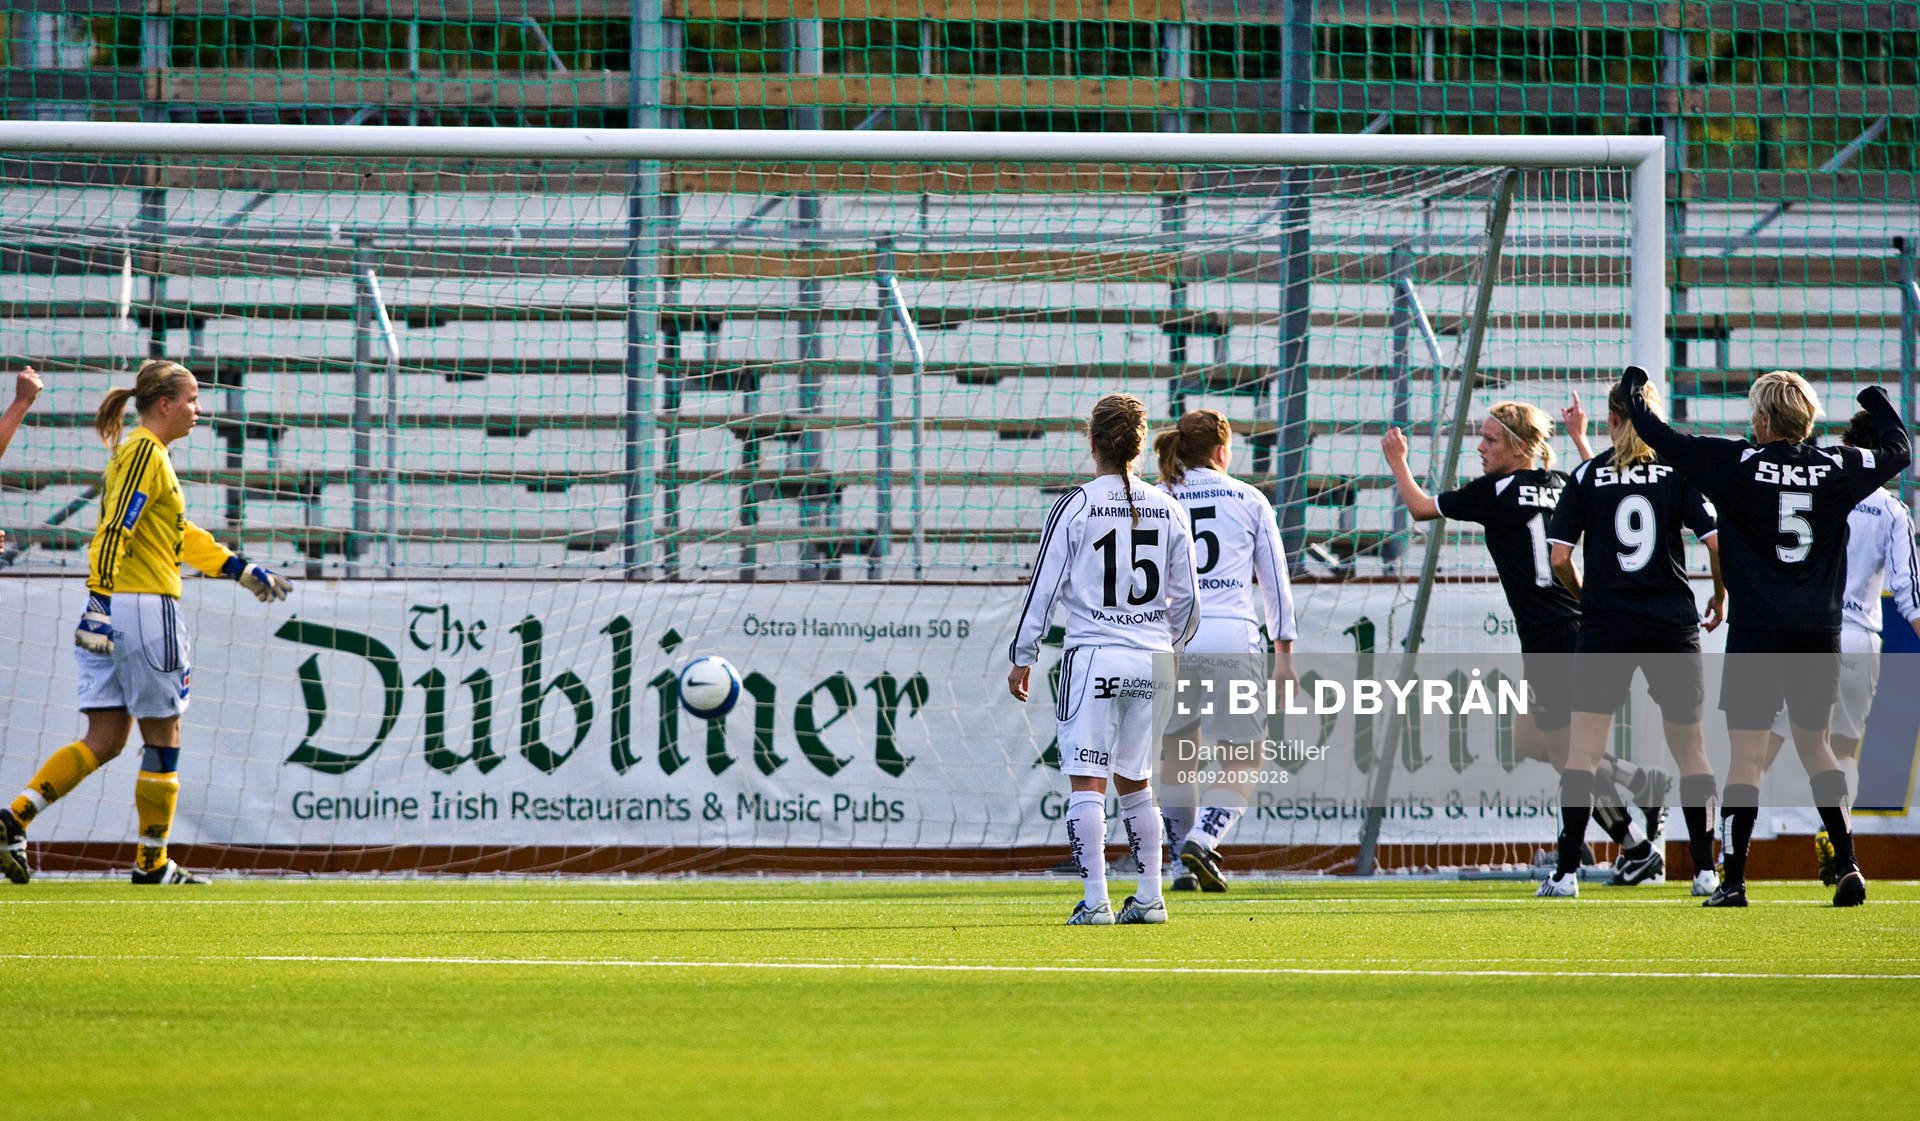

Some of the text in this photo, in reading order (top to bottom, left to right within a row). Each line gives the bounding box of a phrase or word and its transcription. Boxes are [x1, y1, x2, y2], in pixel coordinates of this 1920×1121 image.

[1594, 464, 1673, 487] SKF
[1754, 460, 1831, 487] SKF
[1189, 505, 1220, 574] 5
[1614, 493, 1656, 572] 9
[1775, 491, 1814, 563] 5
[1093, 528, 1160, 609] 15
[408, 603, 487, 655] The
[743, 613, 971, 643] Östra Hamngatan 50 B
[274, 612, 930, 779] Dubliner
[1119, 689, 1155, 700] ENERGI
[292, 789, 905, 822] Genuine Irish Restaurants & Music Pubs
[1444, 789, 1468, 820] &
